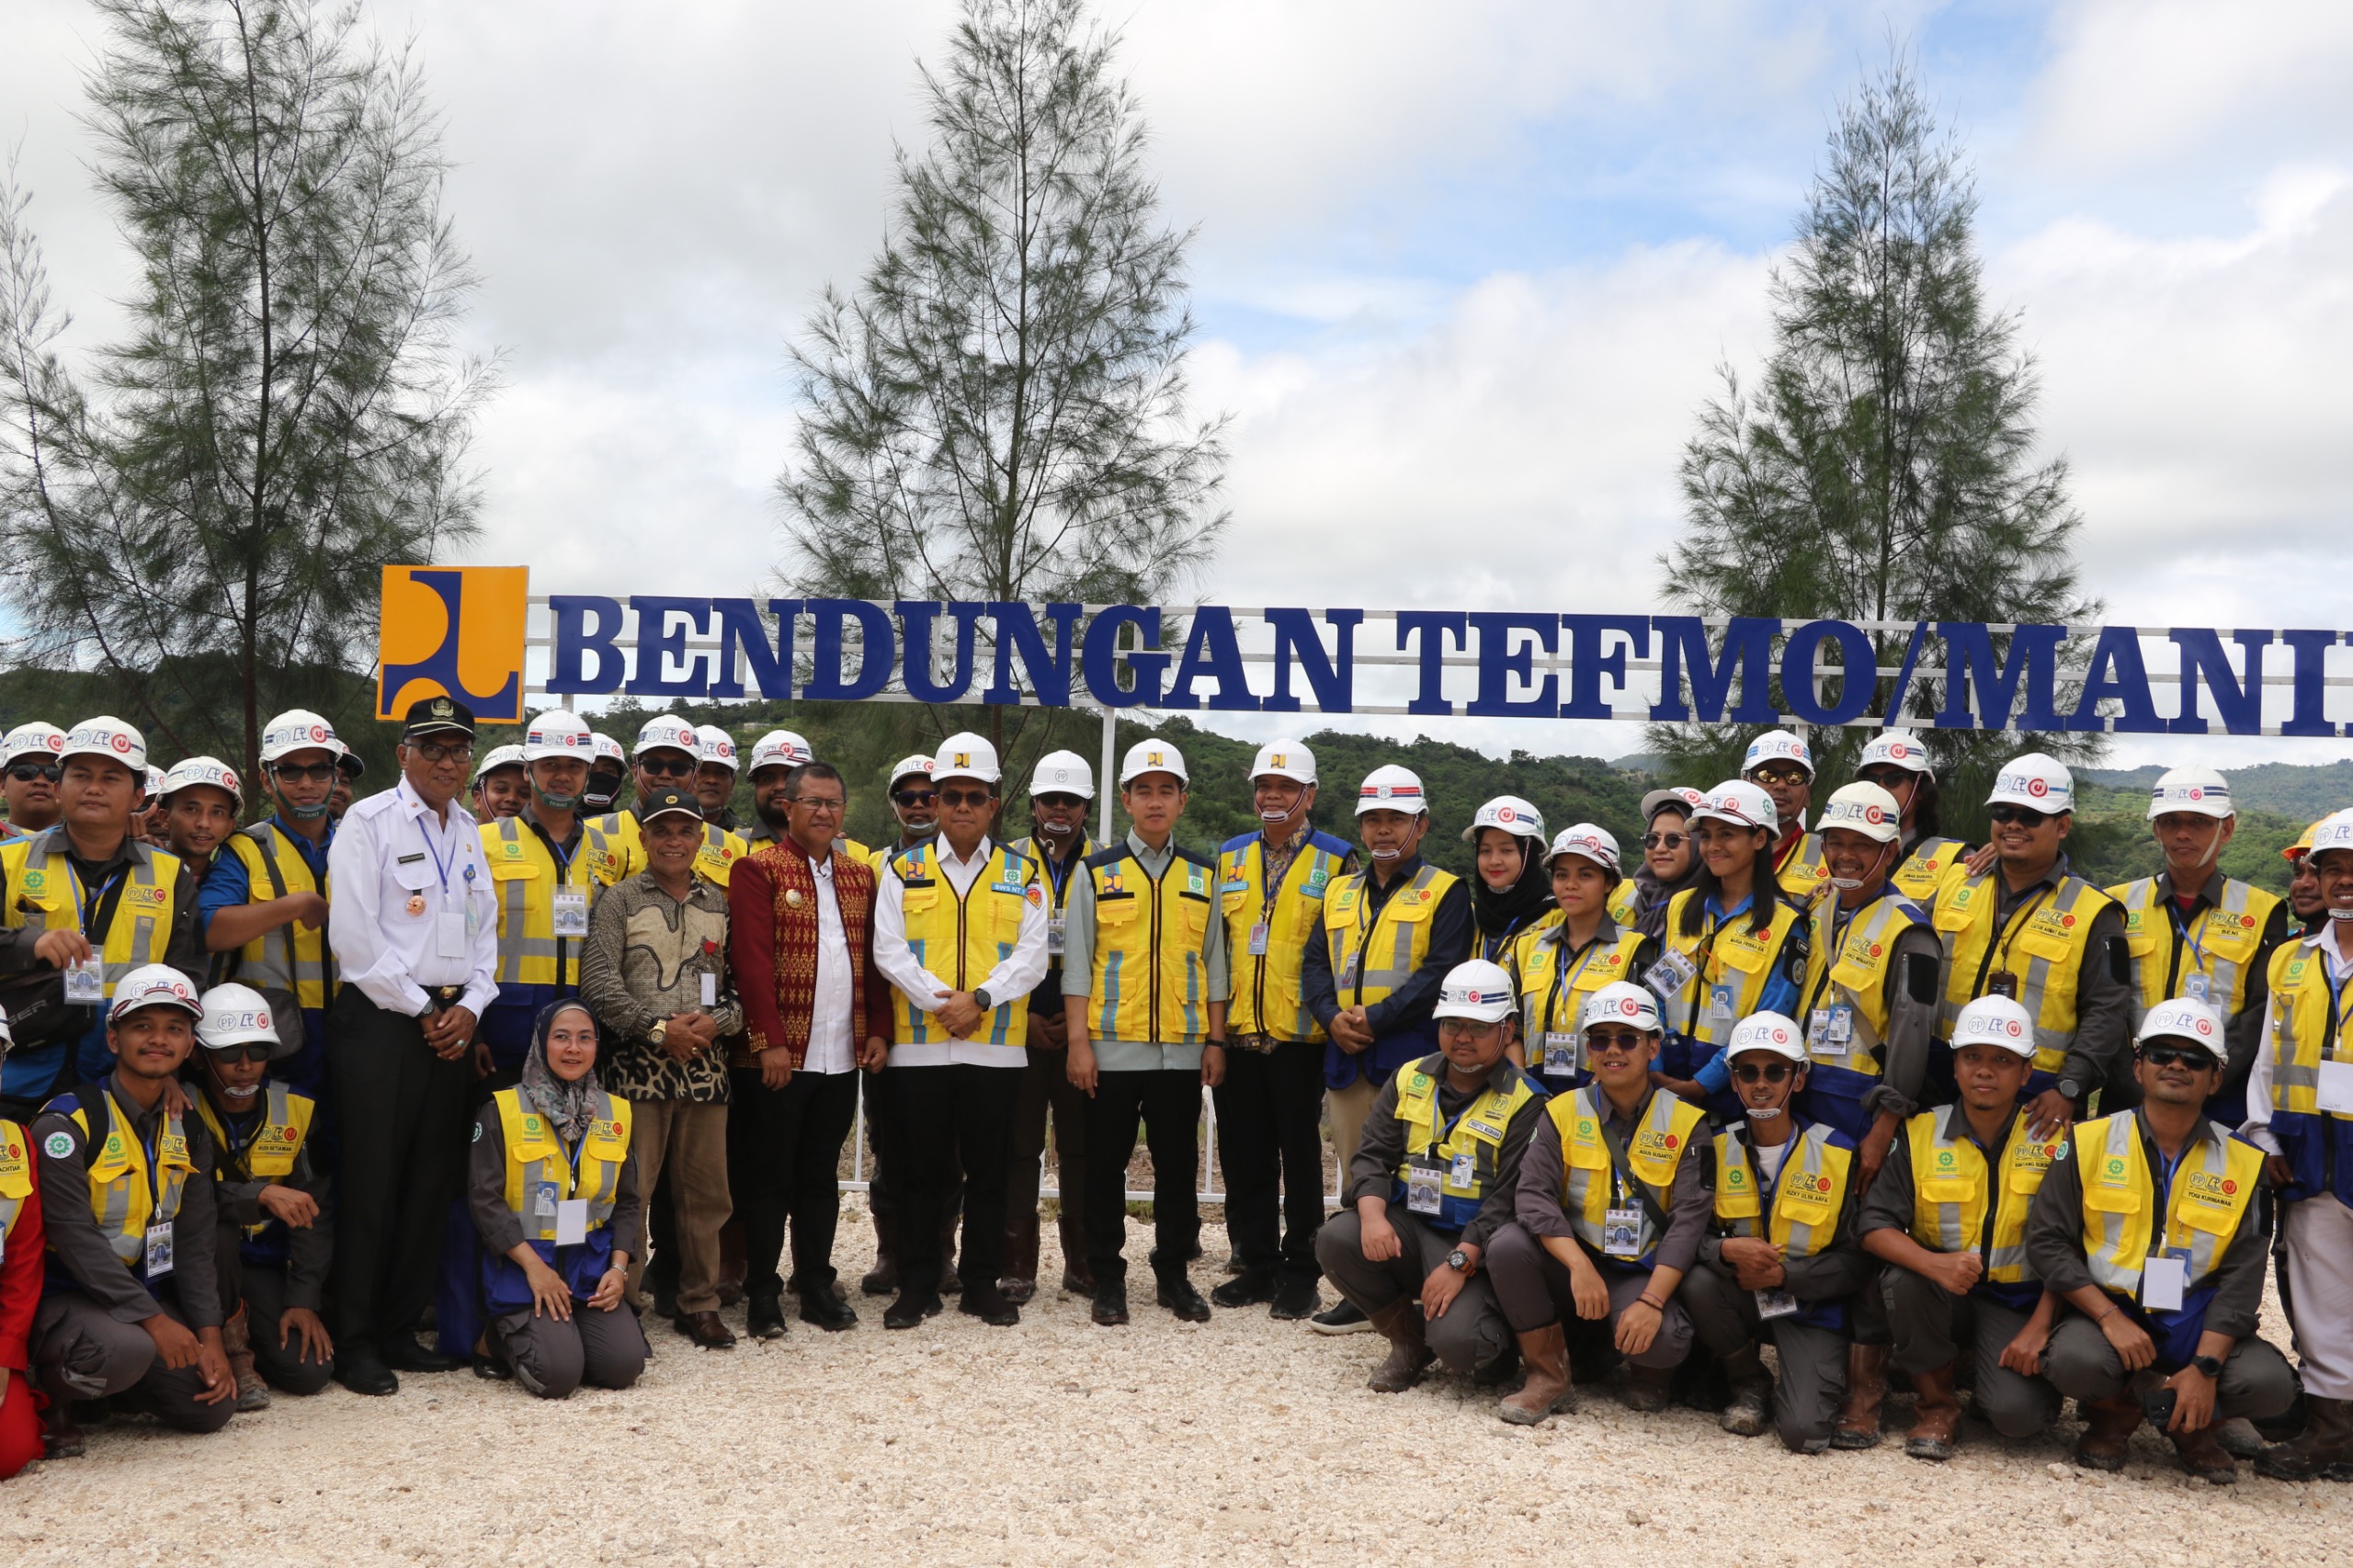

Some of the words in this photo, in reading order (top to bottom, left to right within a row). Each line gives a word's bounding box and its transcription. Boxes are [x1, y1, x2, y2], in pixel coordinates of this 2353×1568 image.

[546, 596, 1363, 713] BENDUNGAN
[1396, 610, 2353, 735] TEFMO/MANI
[1653, 1152, 1672, 1160] SUSANTO
